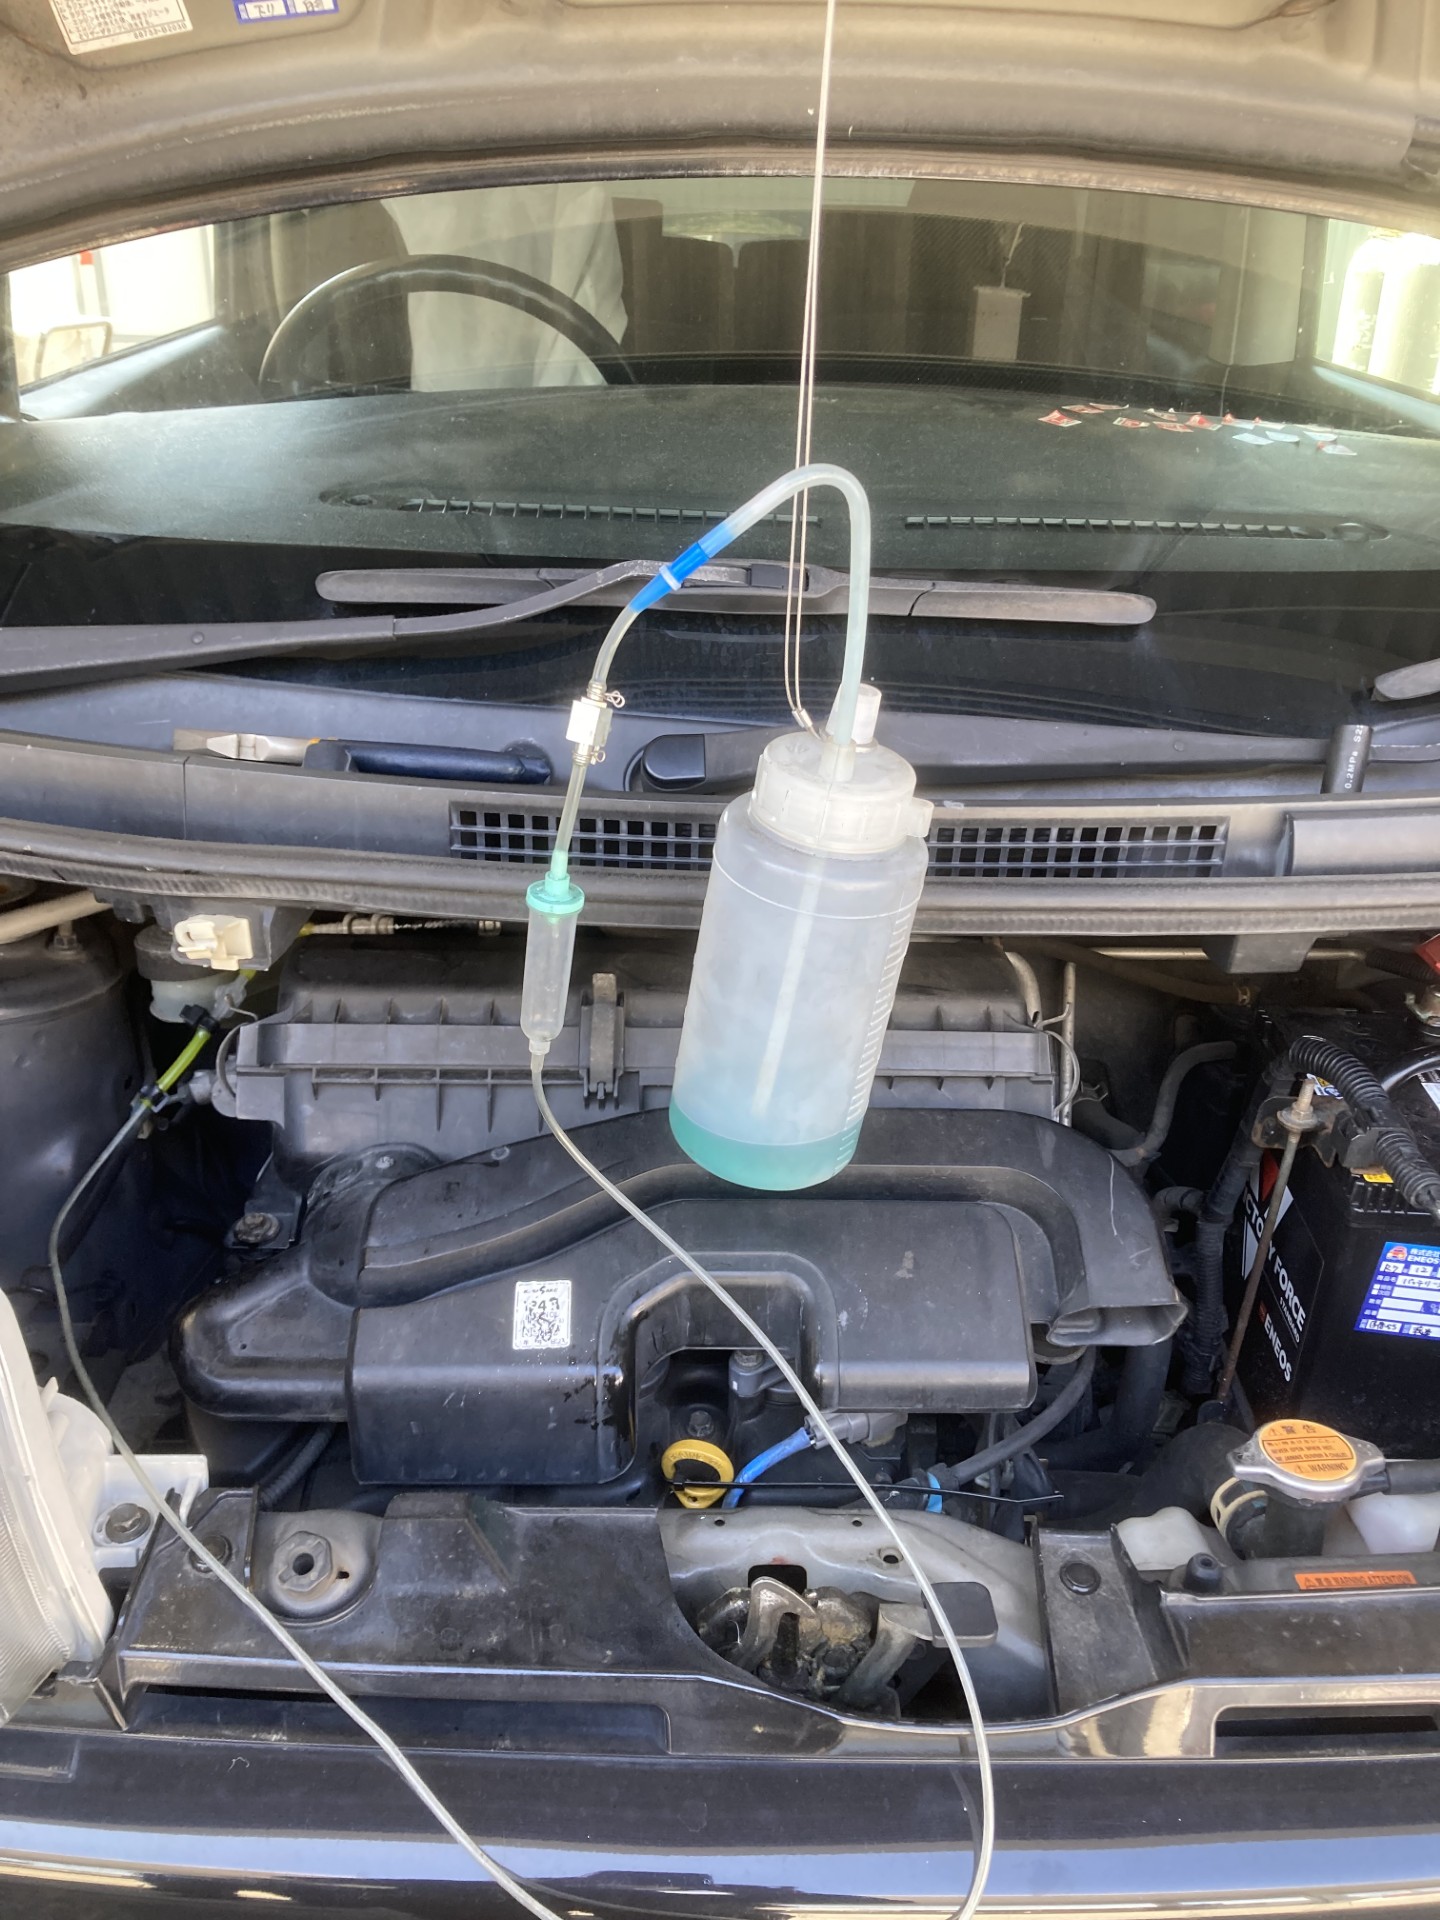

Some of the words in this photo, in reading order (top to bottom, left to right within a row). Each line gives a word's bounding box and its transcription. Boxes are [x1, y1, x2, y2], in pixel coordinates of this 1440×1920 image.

[1344, 751, 1359, 789] 0.2MPa
[1407, 1255, 1440, 1264] ENEOS
[1273, 1255, 1306, 1331] FORCE
[1279, 1297, 1301, 1343] STANDARD
[1264, 1313, 1292, 1382] ENEOS
[1308, 1462, 1349, 1472] WARNING
